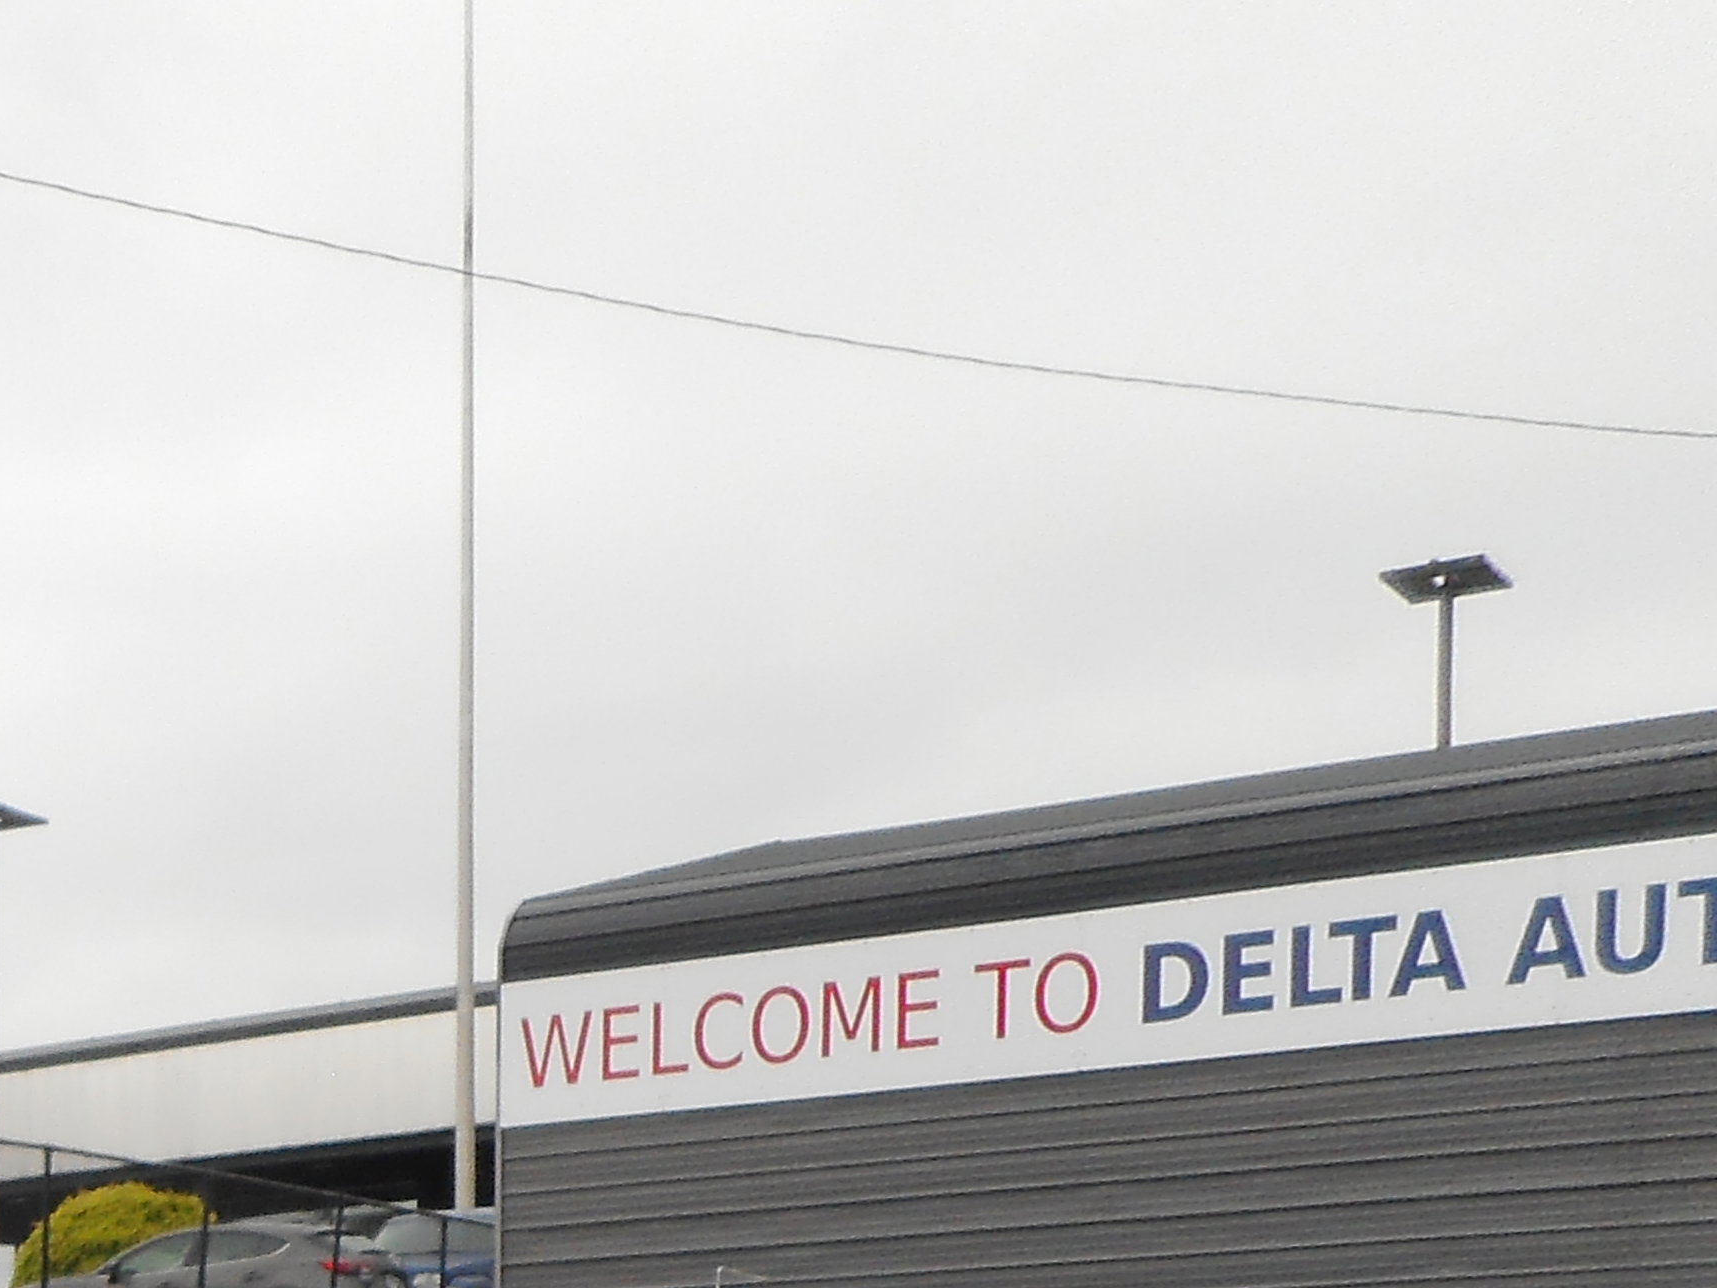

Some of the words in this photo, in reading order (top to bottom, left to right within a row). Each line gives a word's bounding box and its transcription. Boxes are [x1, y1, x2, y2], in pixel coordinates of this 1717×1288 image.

[520, 968, 941, 1089] WELCOME
[973, 951, 1099, 1039] TO
[1140, 908, 1468, 1025] DELTA
